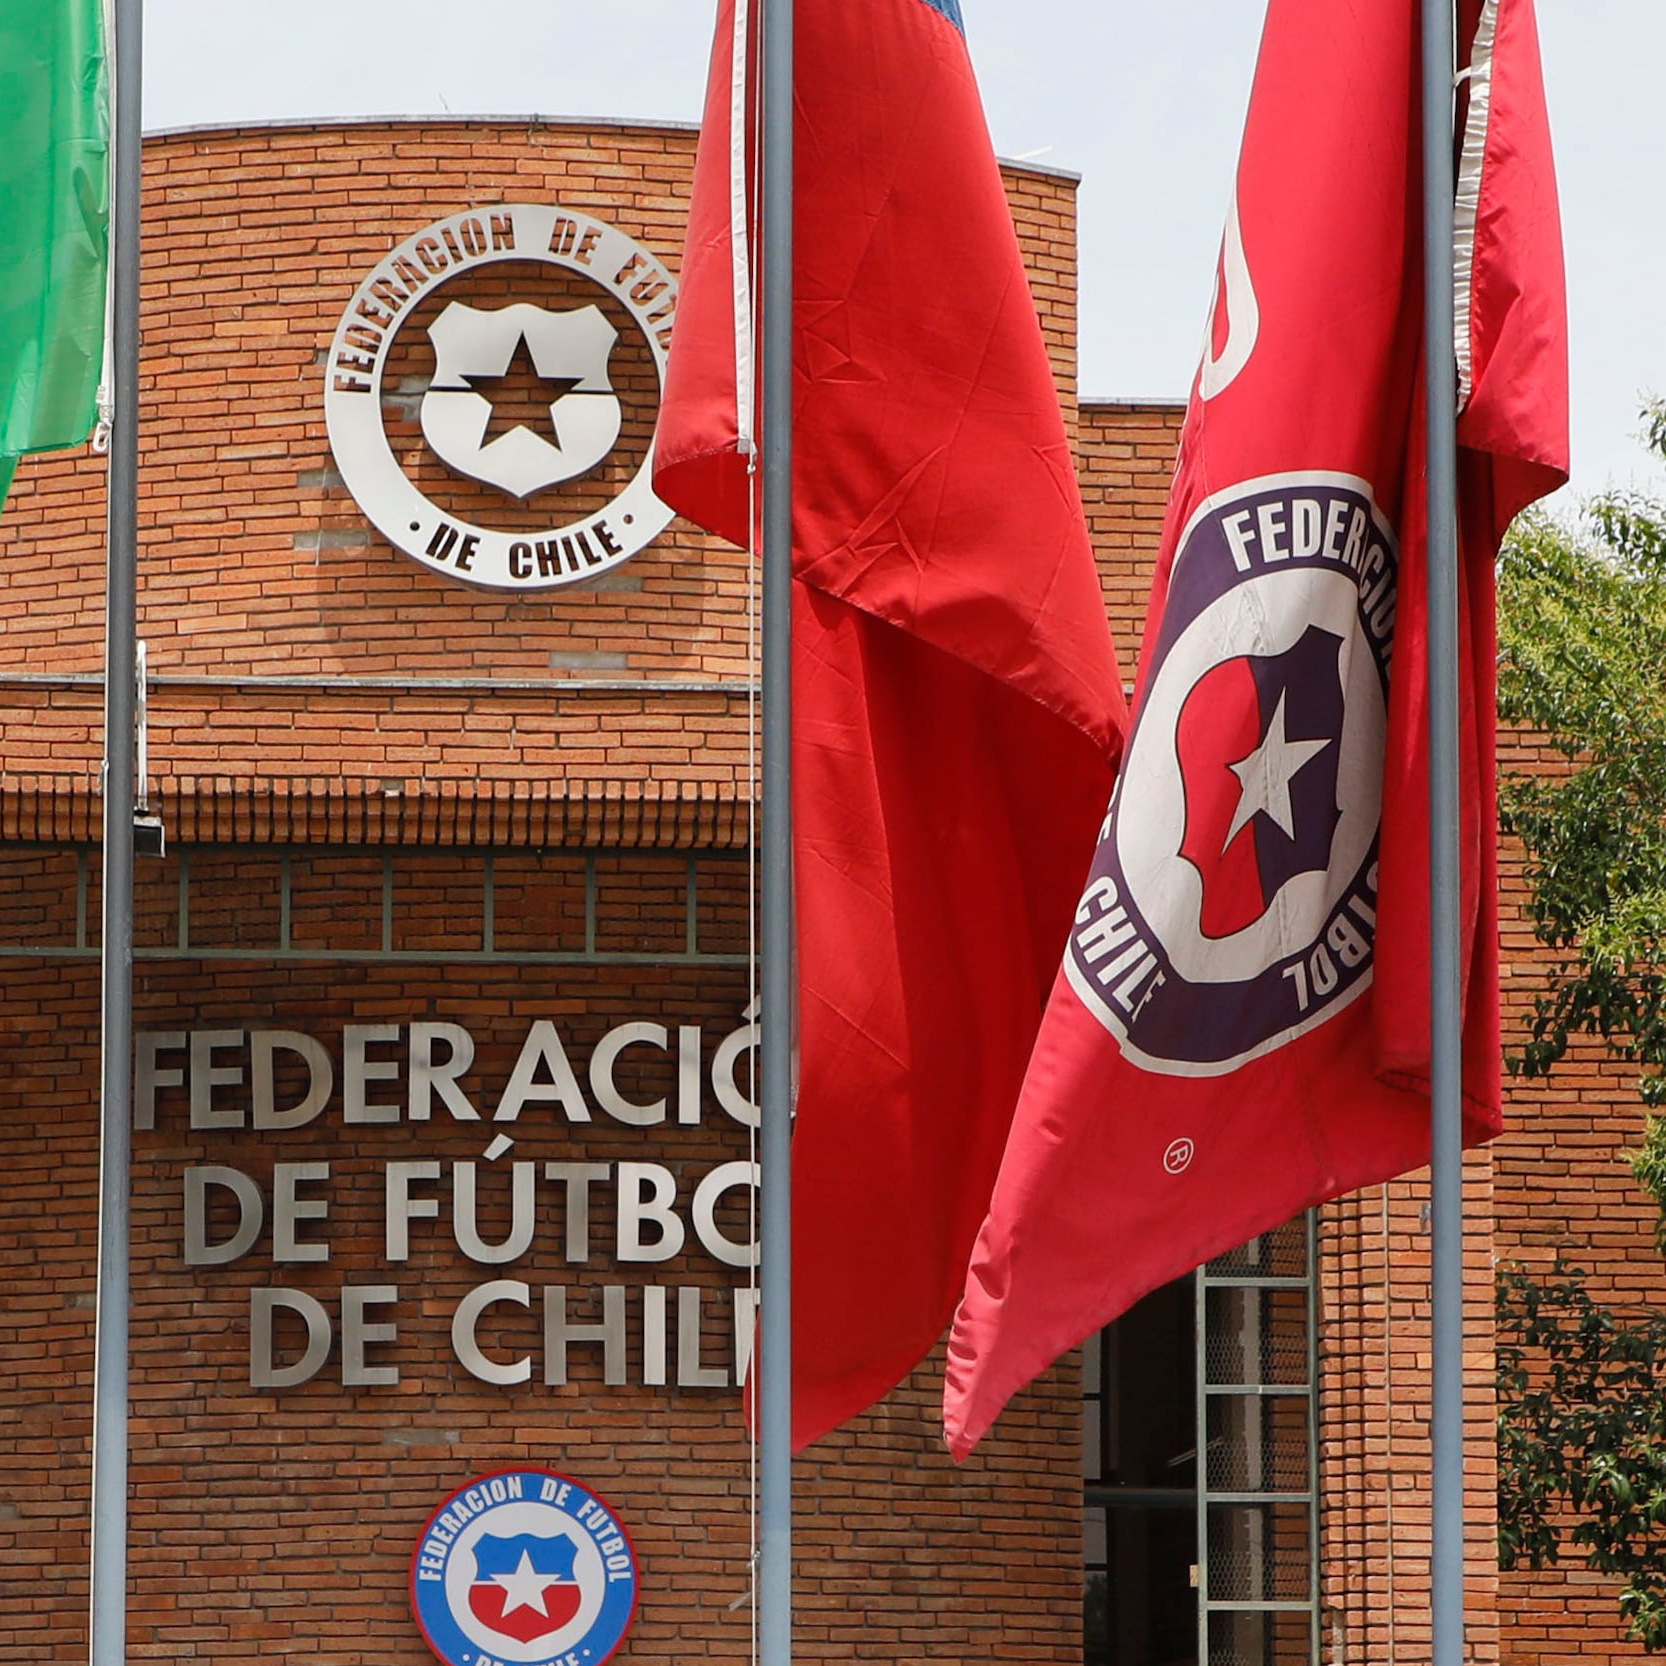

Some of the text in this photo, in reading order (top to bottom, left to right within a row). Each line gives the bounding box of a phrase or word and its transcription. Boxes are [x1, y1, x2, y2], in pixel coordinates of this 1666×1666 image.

[333, 213, 677, 393] FEDERACION DE FUT
[425, 520, 623, 580] DE CHILE
[133, 996, 761, 1130] FEDERACI
[184, 1134, 761, 1267] DE FÚTBO
[250, 1285, 399, 1387] DE
[419, 1476, 632, 1583] FEDERACION DE FUTBOL
